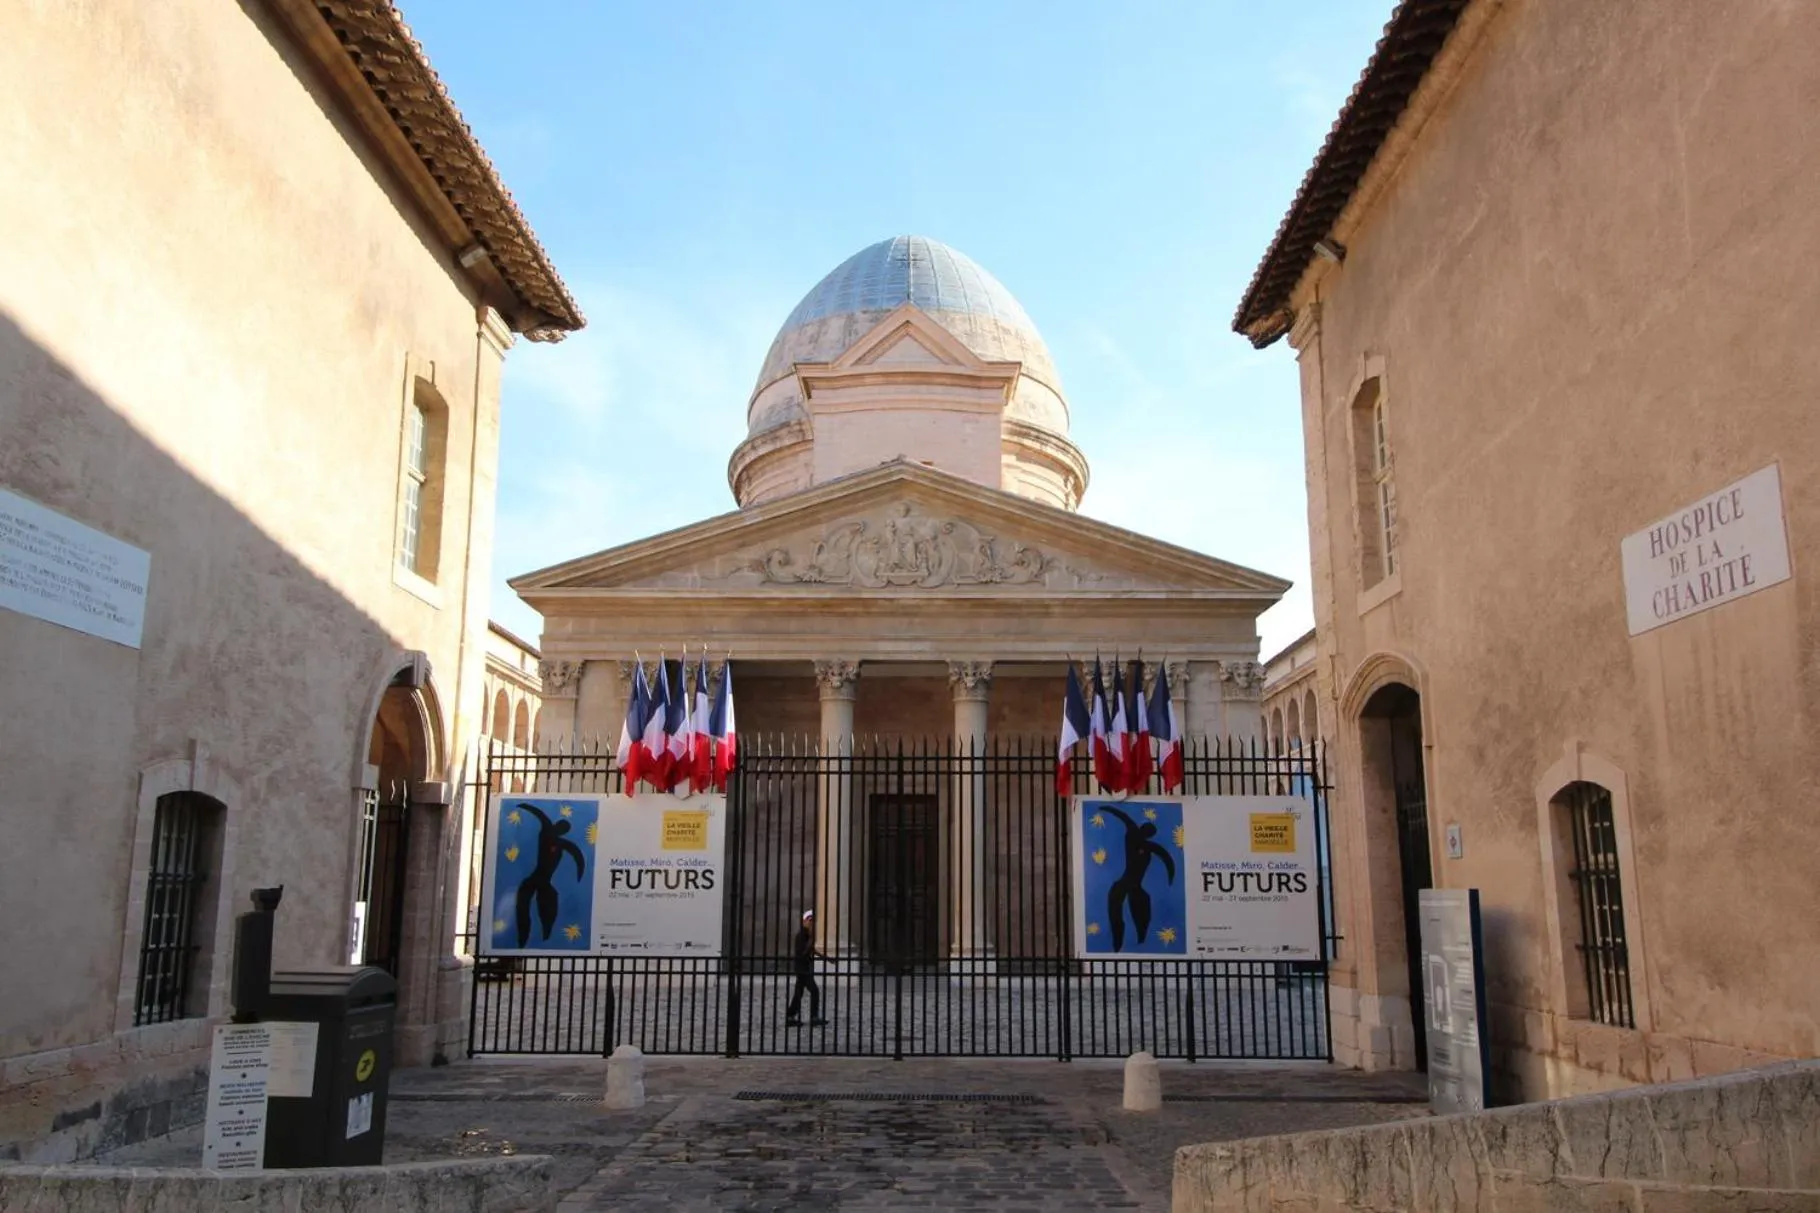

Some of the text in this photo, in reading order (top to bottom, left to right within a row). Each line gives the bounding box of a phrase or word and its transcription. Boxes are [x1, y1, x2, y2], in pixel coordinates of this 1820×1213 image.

[1649, 488, 1744, 559] HOSPICE
[1669, 539, 1724, 579] DE LA
[610, 869, 715, 890] FUTURS
[1202, 872, 1308, 893] FUTURS
